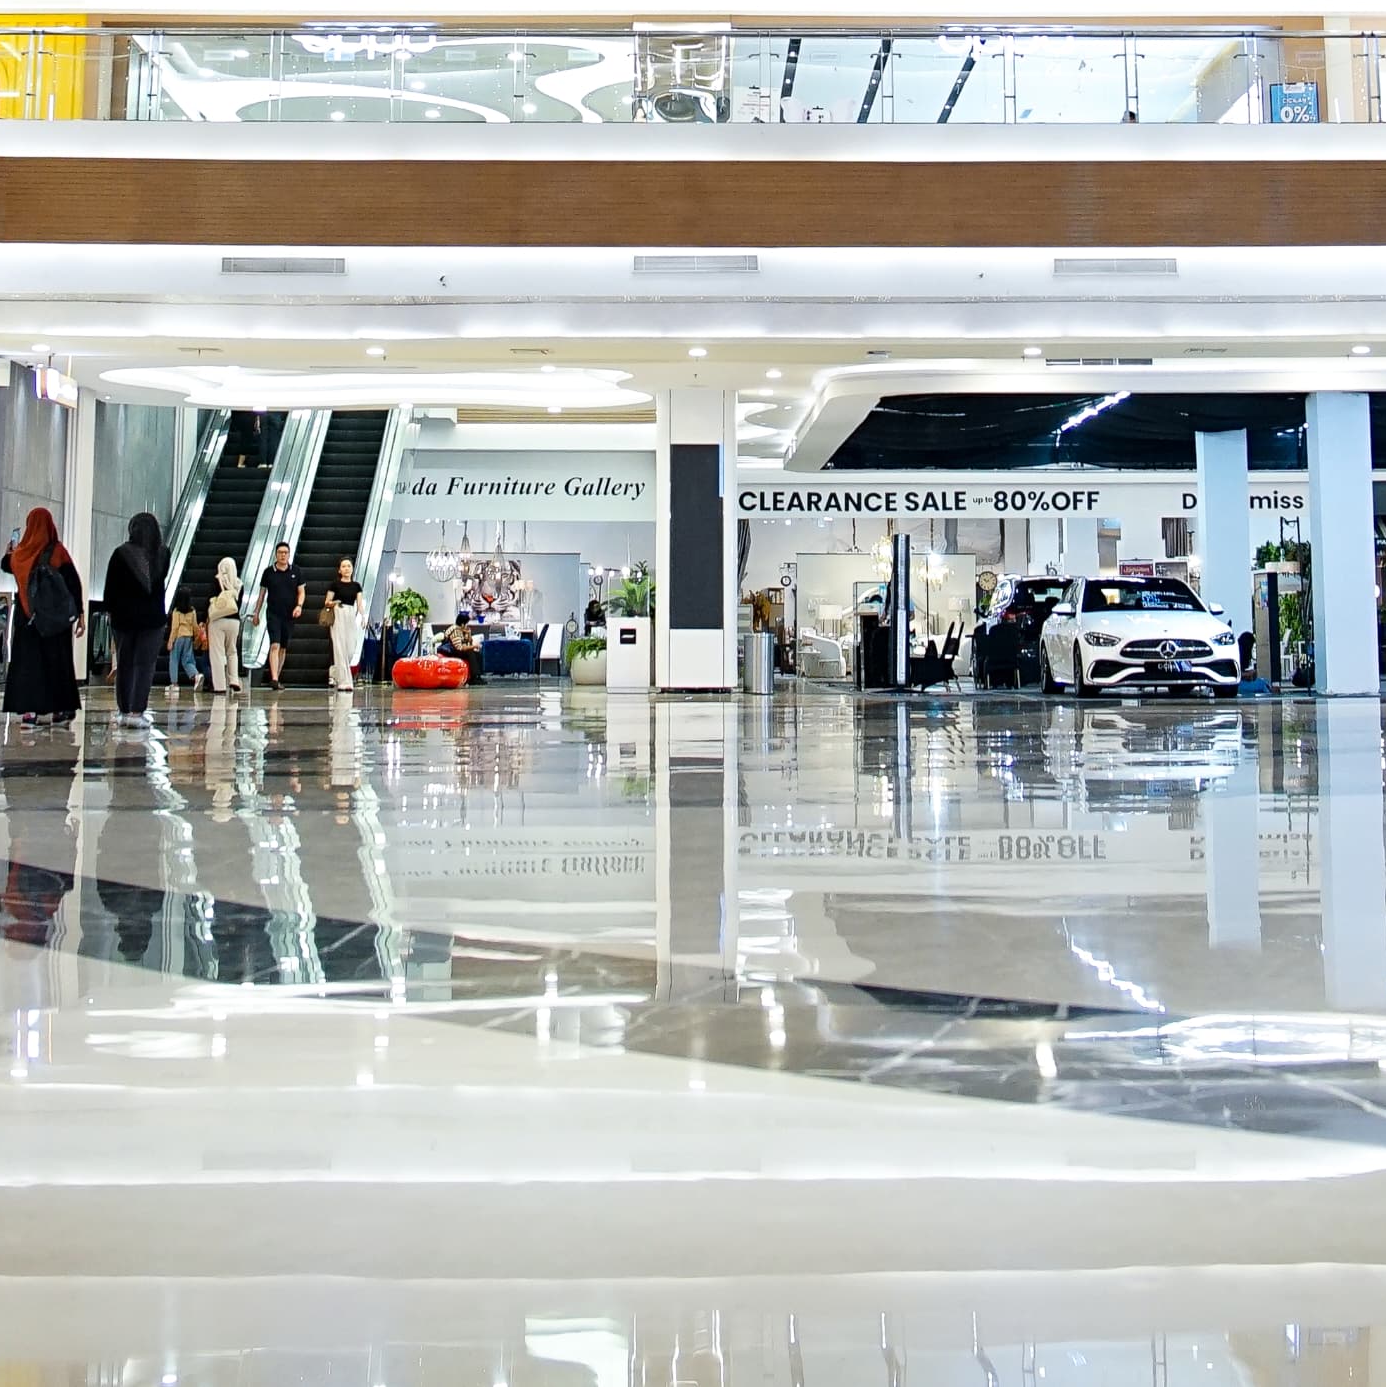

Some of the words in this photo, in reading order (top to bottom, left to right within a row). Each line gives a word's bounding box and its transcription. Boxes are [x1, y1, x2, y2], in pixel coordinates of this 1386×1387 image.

[1280, 105, 1310, 123] 0%
[446, 476, 556, 496] Furniture
[564, 477, 646, 501] Gallery
[738, 491, 898, 512] CLEARANCE
[904, 491, 967, 512] SALE
[972, 497, 984, 505] up
[984, 496, 993, 504] to
[1249, 491, 1304, 510] miss
